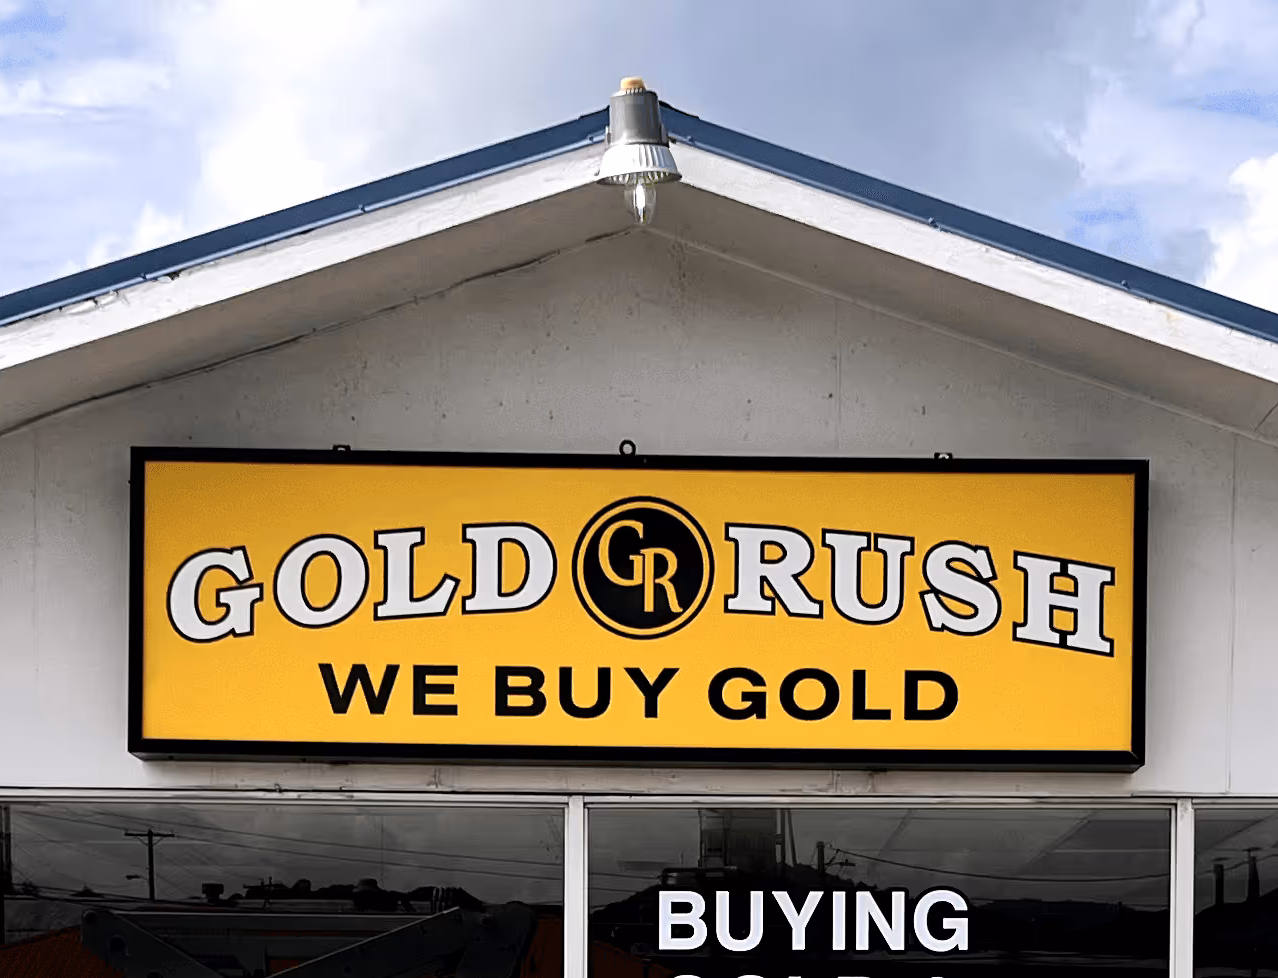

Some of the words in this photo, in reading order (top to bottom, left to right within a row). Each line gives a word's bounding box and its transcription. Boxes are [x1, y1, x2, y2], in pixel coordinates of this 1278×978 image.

[167, 520, 556, 642] GOLD
[722, 520, 1115, 657] RUSH
[599, 520, 682, 613] GR
[319, 663, 458, 716] WE
[495, 666, 681, 720] BUY
[708, 667, 960, 722] GOLD
[658, 890, 969, 952] BUYING
